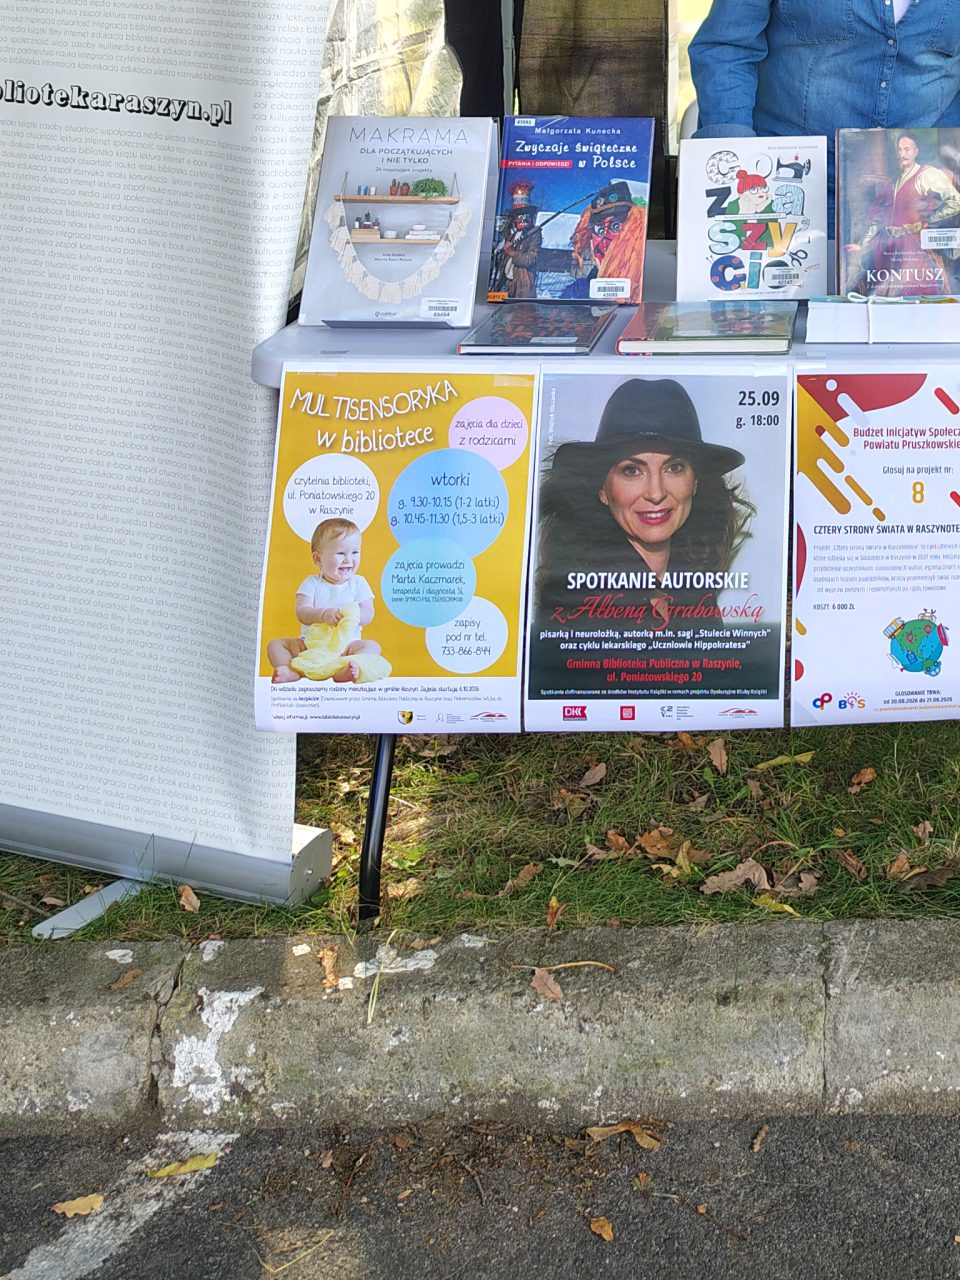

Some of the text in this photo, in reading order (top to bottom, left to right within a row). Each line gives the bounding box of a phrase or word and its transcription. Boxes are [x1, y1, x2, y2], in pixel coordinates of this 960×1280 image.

[349, 127, 468, 144] MAKRAMA
[360, 147, 453, 157] DLA POCZĄTKUJĄCYCH
[516, 140, 638, 155] Zwyczaje świąteczne
[578, 156, 637, 168] w Polsce
[866, 268, 945, 282] KONTUSZ
[738, 391, 780, 406] 25.09
[455, 419, 523, 430] zajęcia dla dzieci
[736, 414, 780, 429] g. 18:00
[853, 427, 884, 437] Budżet
[886, 427, 926, 439] Inicjatyw
[316, 426, 434, 453] w bibliotece
[459, 435, 516, 446] z rodzicami
[864, 440, 900, 449] Powiatu
[883, 465, 905, 475] Głosuj
[917, 465, 942, 475] projekt
[944, 466, 954, 474] nr:
[294, 476, 371, 487] czytelnia biblioteki,
[431, 472, 470, 486] wtorki
[288, 490, 375, 502] ul. Poniatowskiego 20
[912, 481, 925, 504] 8
[398, 496, 500, 510] g. 9.30-10.15 (1-2 latki)
[320, 505, 354, 516] Raszynie
[391, 512, 505, 527] g. 10.45-11.30 (1,5-3 latki)
[814, 525, 841, 535] CZTERY
[843, 525, 874, 534] STRONY
[876, 524, 905, 534] ŚWIATA
[907, 525, 914, 534] W
[394, 560, 465, 572] zajęcia prowadzi
[392, 574, 465, 585] Marta Kaczmarek,
[567, 572, 749, 590] SPOTKANIE AUTORSKIE
[549, 604, 567, 623] z
[651, 593, 764, 630] Grabowską
[454, 618, 481, 629] zapisy
[446, 633, 462, 642] pod
[475, 632, 487, 641] tel.
[442, 646, 491, 656] 733-866-844
[567, 658, 742, 670] Gminna Biblioteka Publiczna w Raszynie,
[607, 671, 702, 684] ul. Poniatowskiego 20
